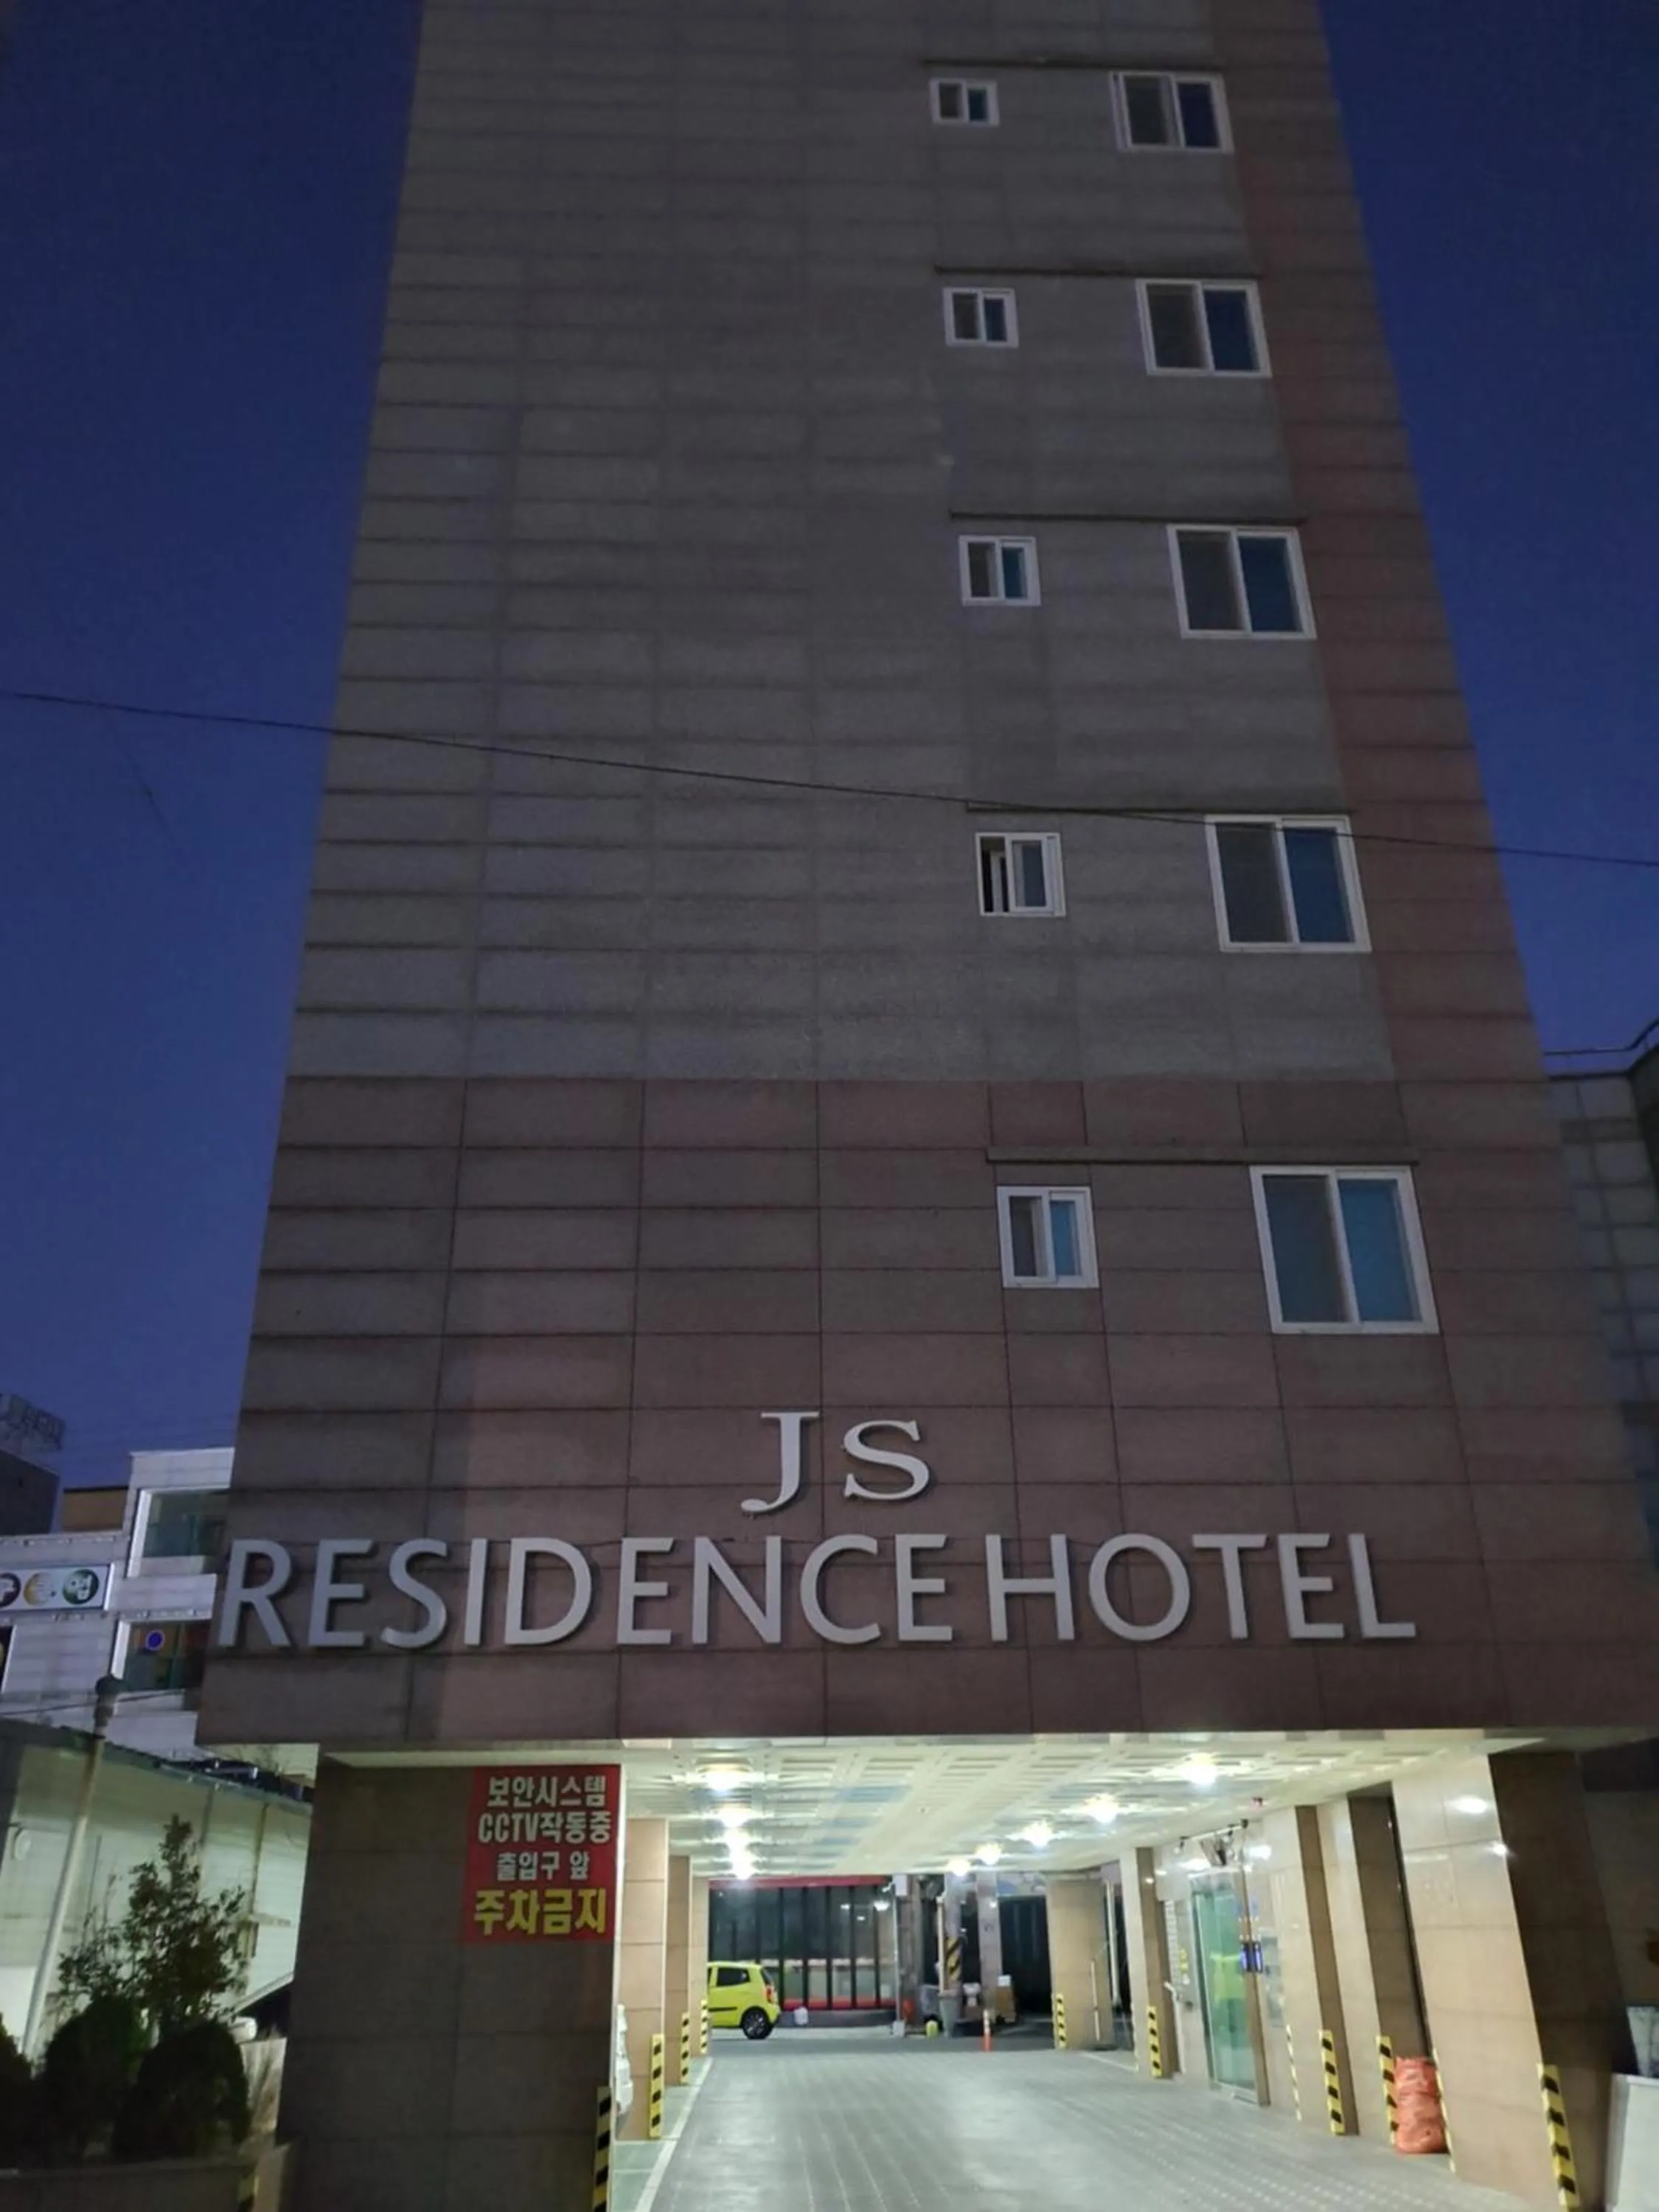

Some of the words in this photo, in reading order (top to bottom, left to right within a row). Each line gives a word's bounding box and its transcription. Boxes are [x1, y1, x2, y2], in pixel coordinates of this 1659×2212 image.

[740, 1411, 931, 1513] JS
[487, 1775, 607, 1807] 보안시스템
[479, 1811, 612, 1843] CCTV작동중
[497, 1851, 560, 1882] 출입구
[569, 1851, 590, 1880] 앞
[473, 1888, 607, 1935] 주차금지
